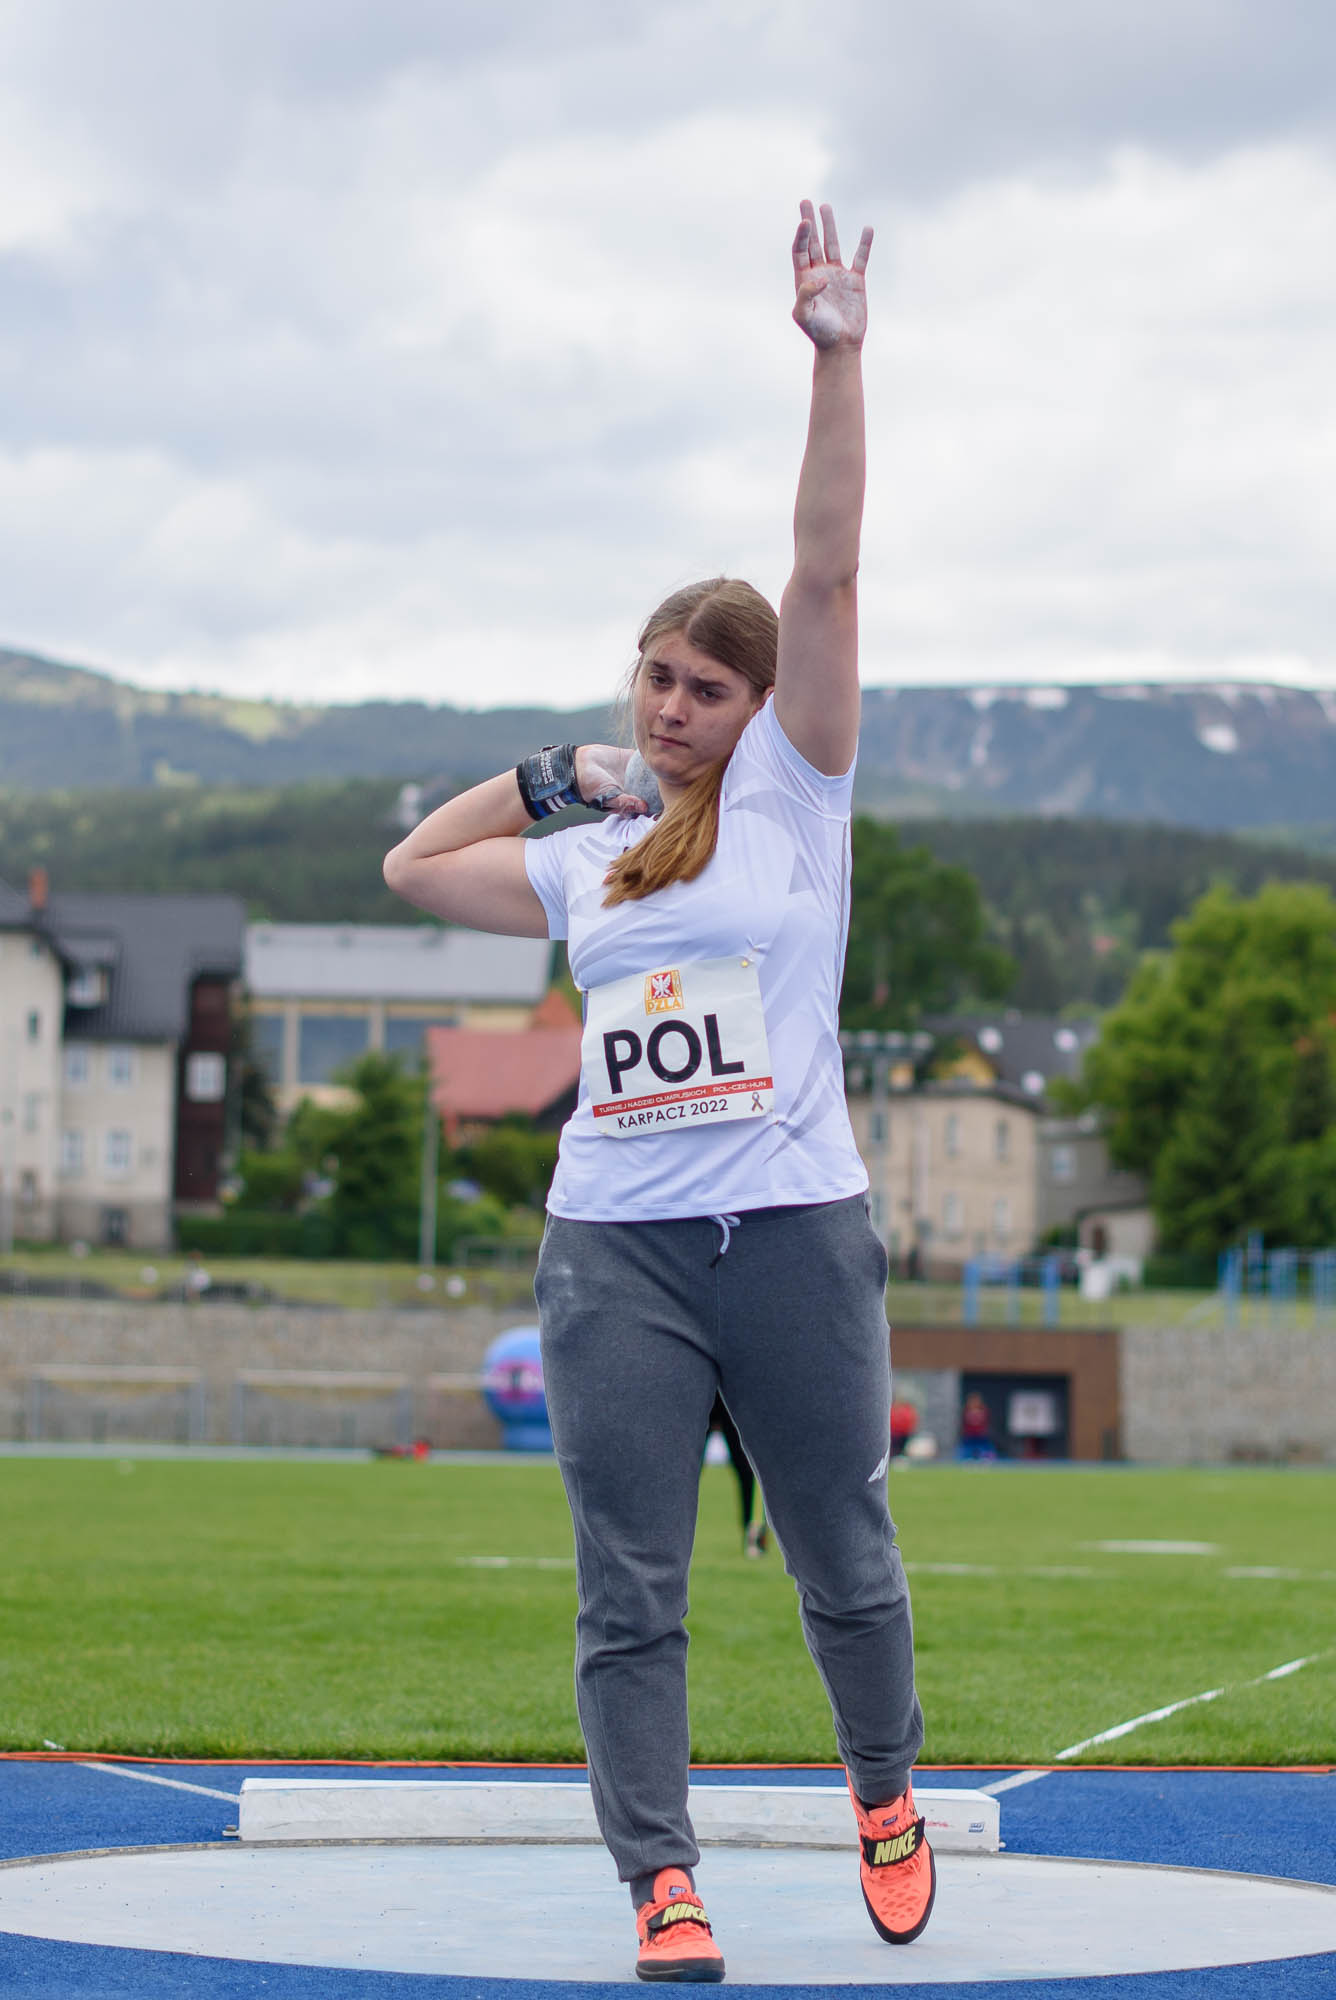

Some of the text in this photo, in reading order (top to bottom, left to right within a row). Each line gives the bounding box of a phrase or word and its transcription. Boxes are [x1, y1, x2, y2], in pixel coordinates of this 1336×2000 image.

[603, 1013, 745, 1095] POL
[617, 1098, 729, 1129] KARPACZ 2022
[873, 1825, 916, 1865] NIKE
[662, 1903, 708, 1925] NIKE
